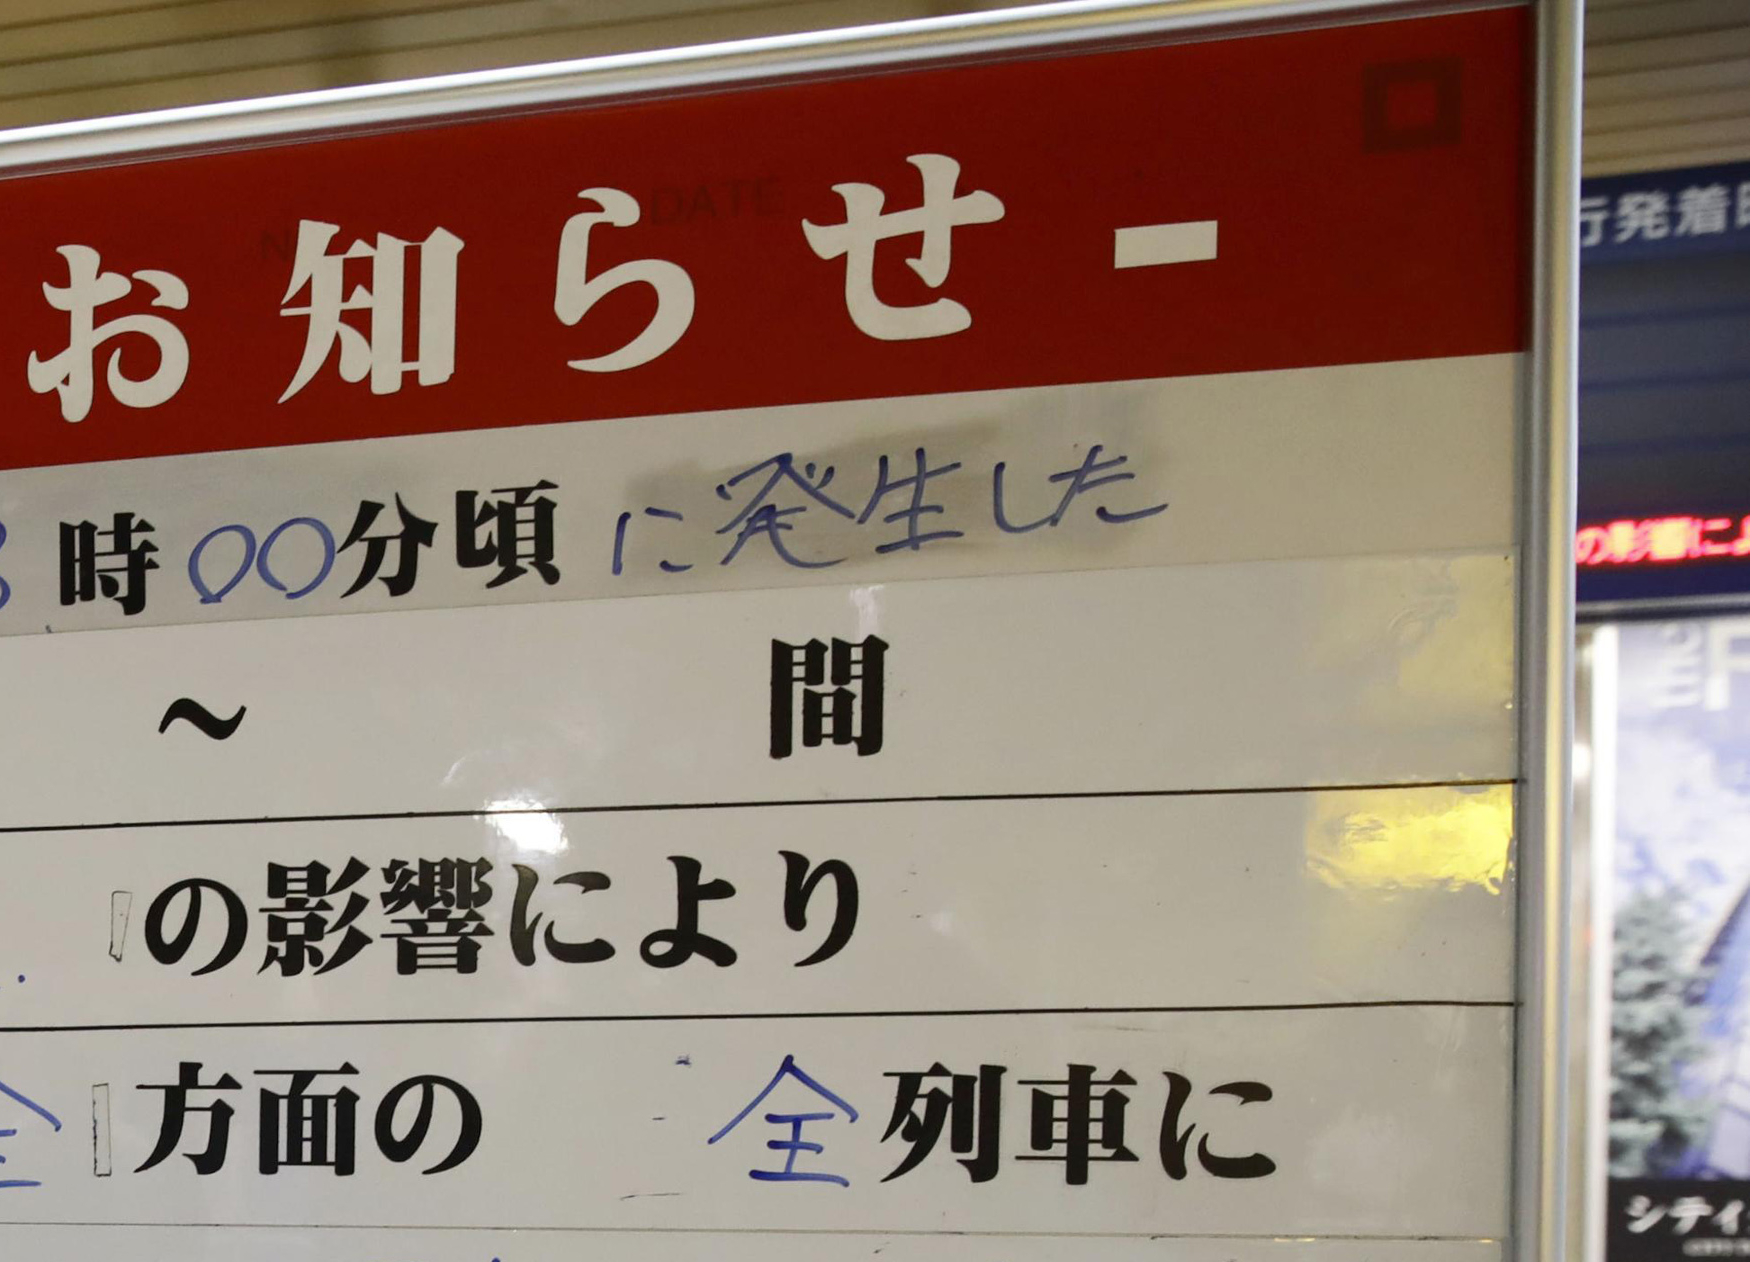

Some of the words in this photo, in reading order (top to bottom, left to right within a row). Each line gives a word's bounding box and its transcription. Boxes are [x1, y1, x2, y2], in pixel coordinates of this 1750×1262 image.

[769, 635, 890, 760] 間
[143, 849, 861, 979] の影響により
[134, 1060, 483, 1177] 方面の
